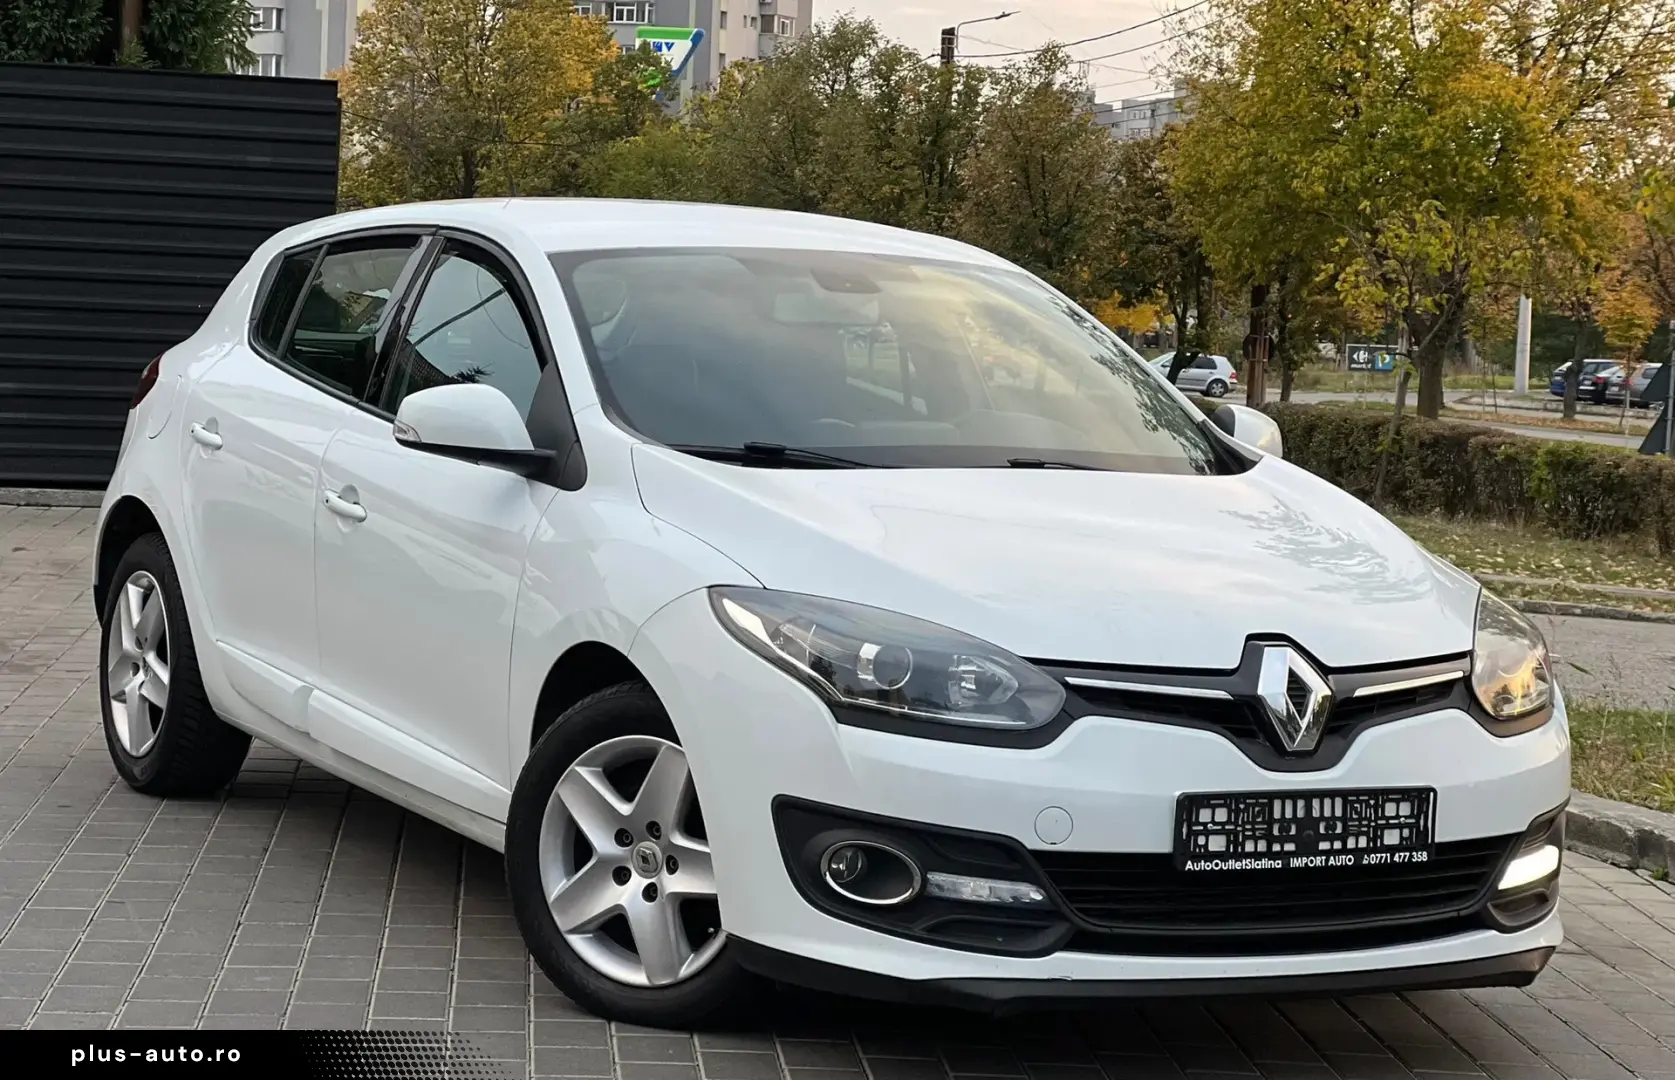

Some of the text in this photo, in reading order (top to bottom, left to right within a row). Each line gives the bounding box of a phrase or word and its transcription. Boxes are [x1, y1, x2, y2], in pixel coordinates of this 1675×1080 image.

[1184, 851, 1428, 871] AutoOutletSlatina IMPORT AUTO 0771 477 358
